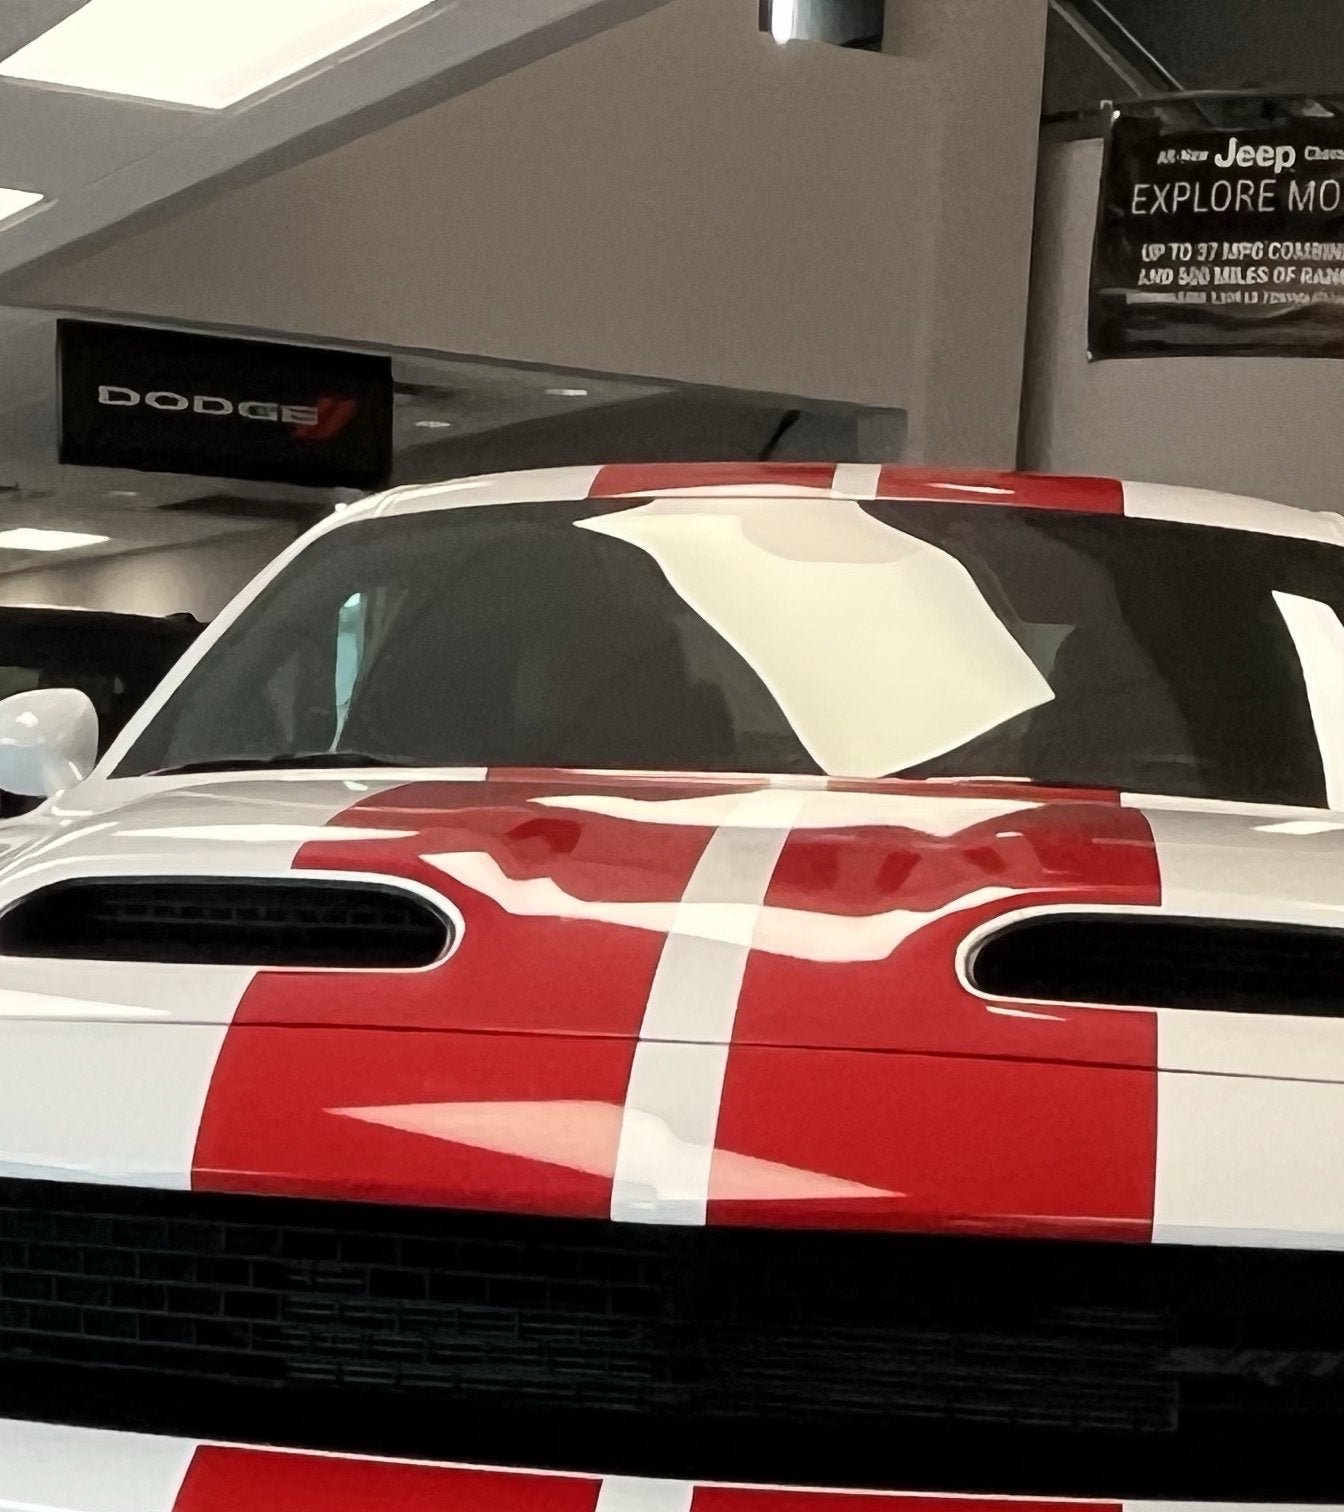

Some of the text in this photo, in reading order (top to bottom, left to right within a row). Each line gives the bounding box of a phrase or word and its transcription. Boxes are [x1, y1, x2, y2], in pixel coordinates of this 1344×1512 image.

[1214, 136, 1296, 174] Jeep
[1131, 179, 1277, 215] EXPLORE
[1168, 242, 1193, 262] TO
[1138, 267, 1174, 286] AND
[1214, 265, 1269, 286] MILES
[1272, 266, 1297, 285] OF
[98, 384, 319, 426] DODGE
